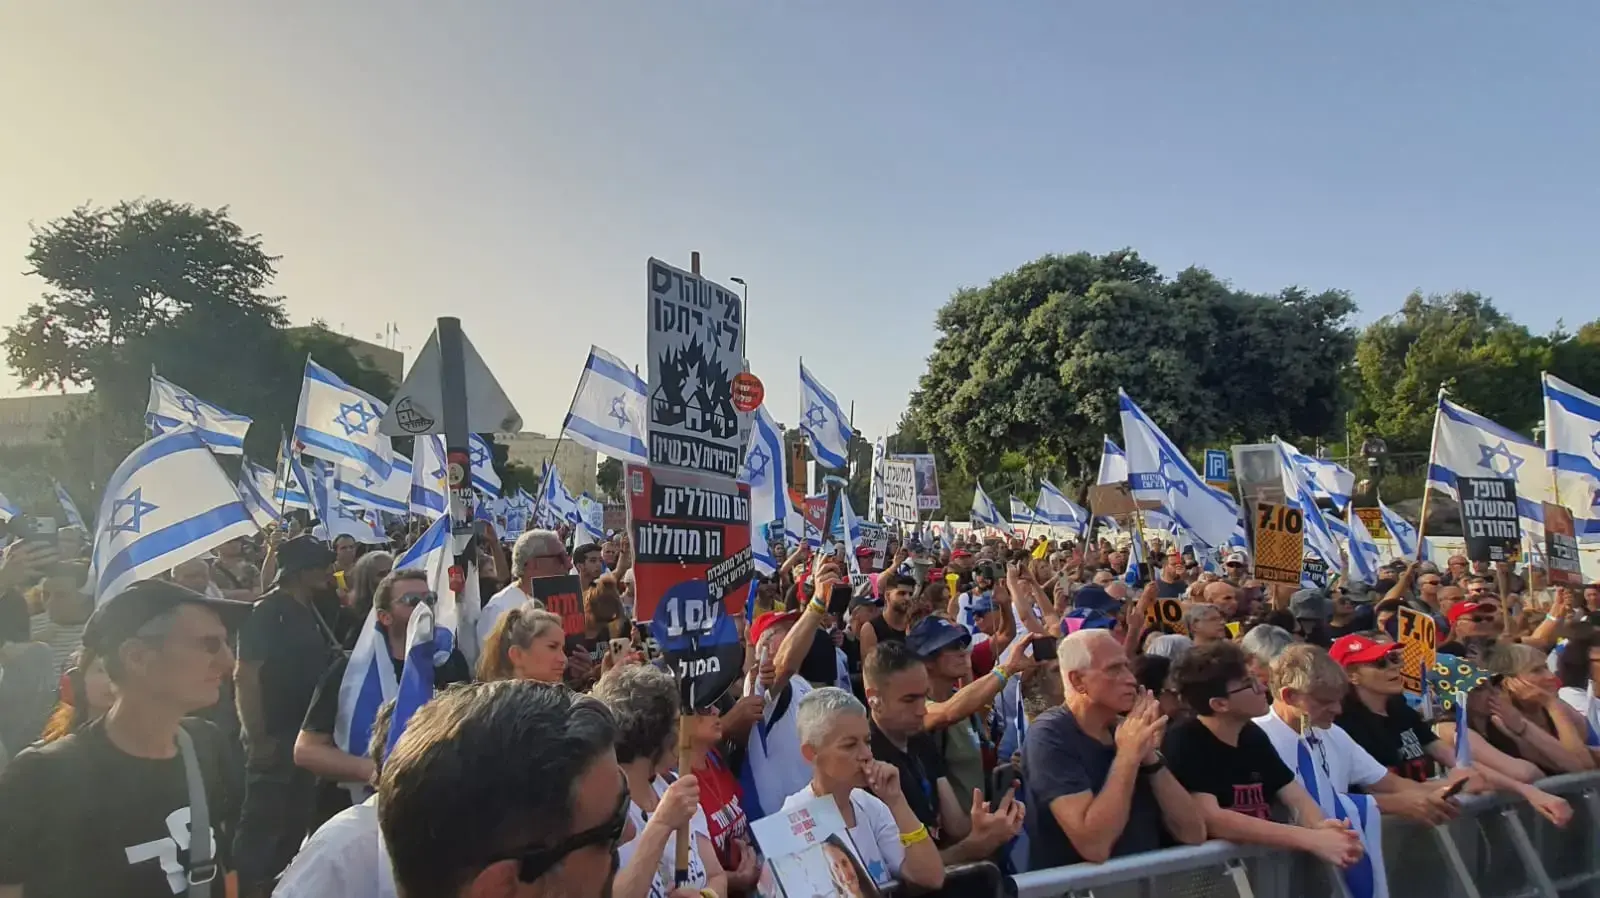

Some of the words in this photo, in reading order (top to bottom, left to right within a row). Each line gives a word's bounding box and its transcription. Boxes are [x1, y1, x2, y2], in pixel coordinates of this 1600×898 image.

[653, 298, 703, 335] יתקן
[707, 317, 739, 352] לא
[652, 433, 703, 470] עכשיו!
[703, 444, 736, 473] בחירות
[734, 496, 750, 521] הם
[1258, 503, 1303, 534] 7.10
[1463, 498, 1517, 518] ממשלת
[1468, 519, 1518, 538] החורבן
[705, 530, 721, 558] הן
[1144, 600, 1182, 622] .10
[1400, 610, 1435, 650] 7.10
